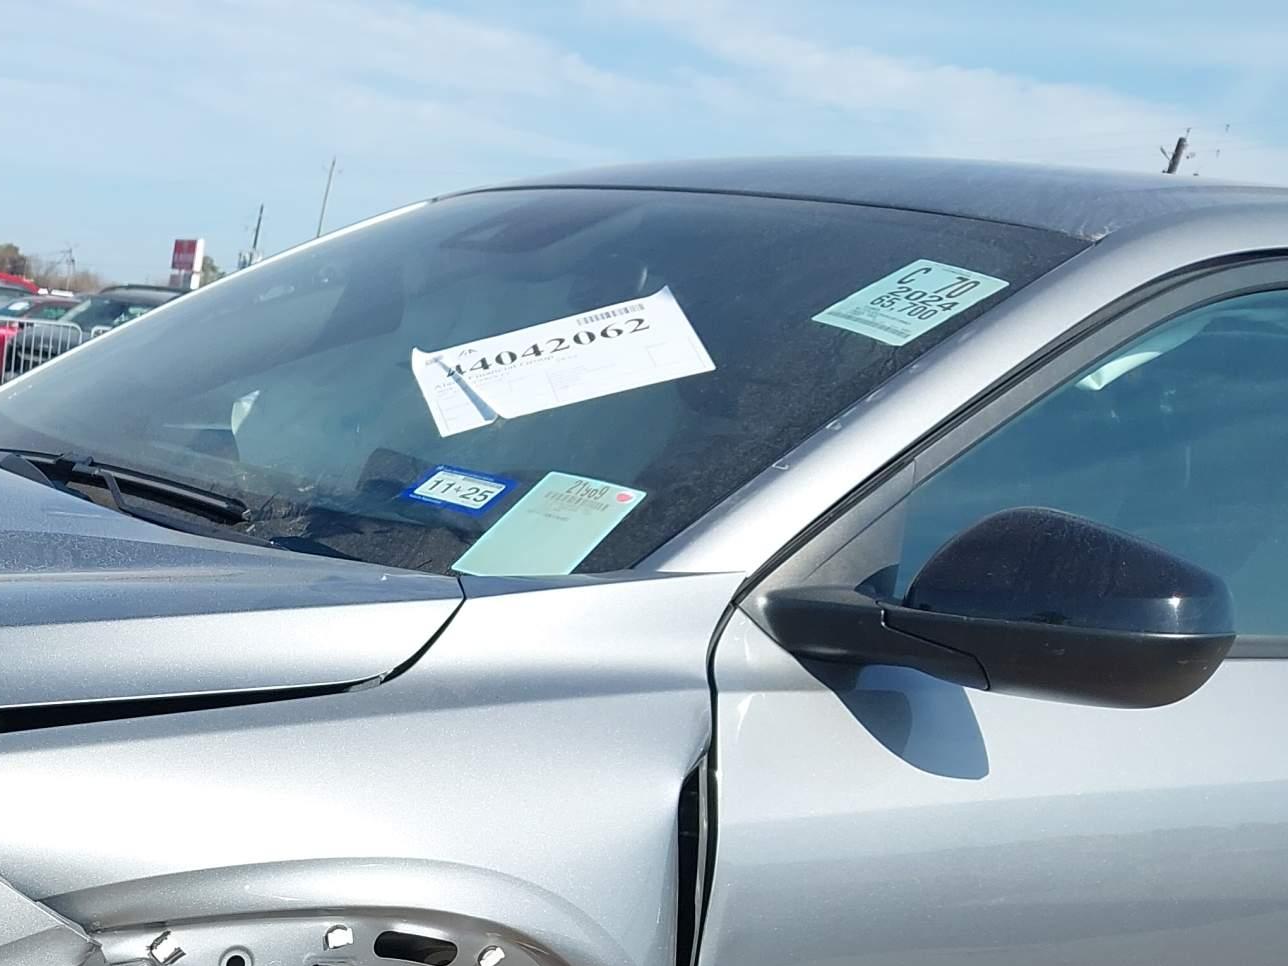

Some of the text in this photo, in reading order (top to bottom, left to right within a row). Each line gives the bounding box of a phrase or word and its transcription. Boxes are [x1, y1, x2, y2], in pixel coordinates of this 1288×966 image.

[897, 267, 982, 298] C 70
[888, 286, 961, 312] 2024
